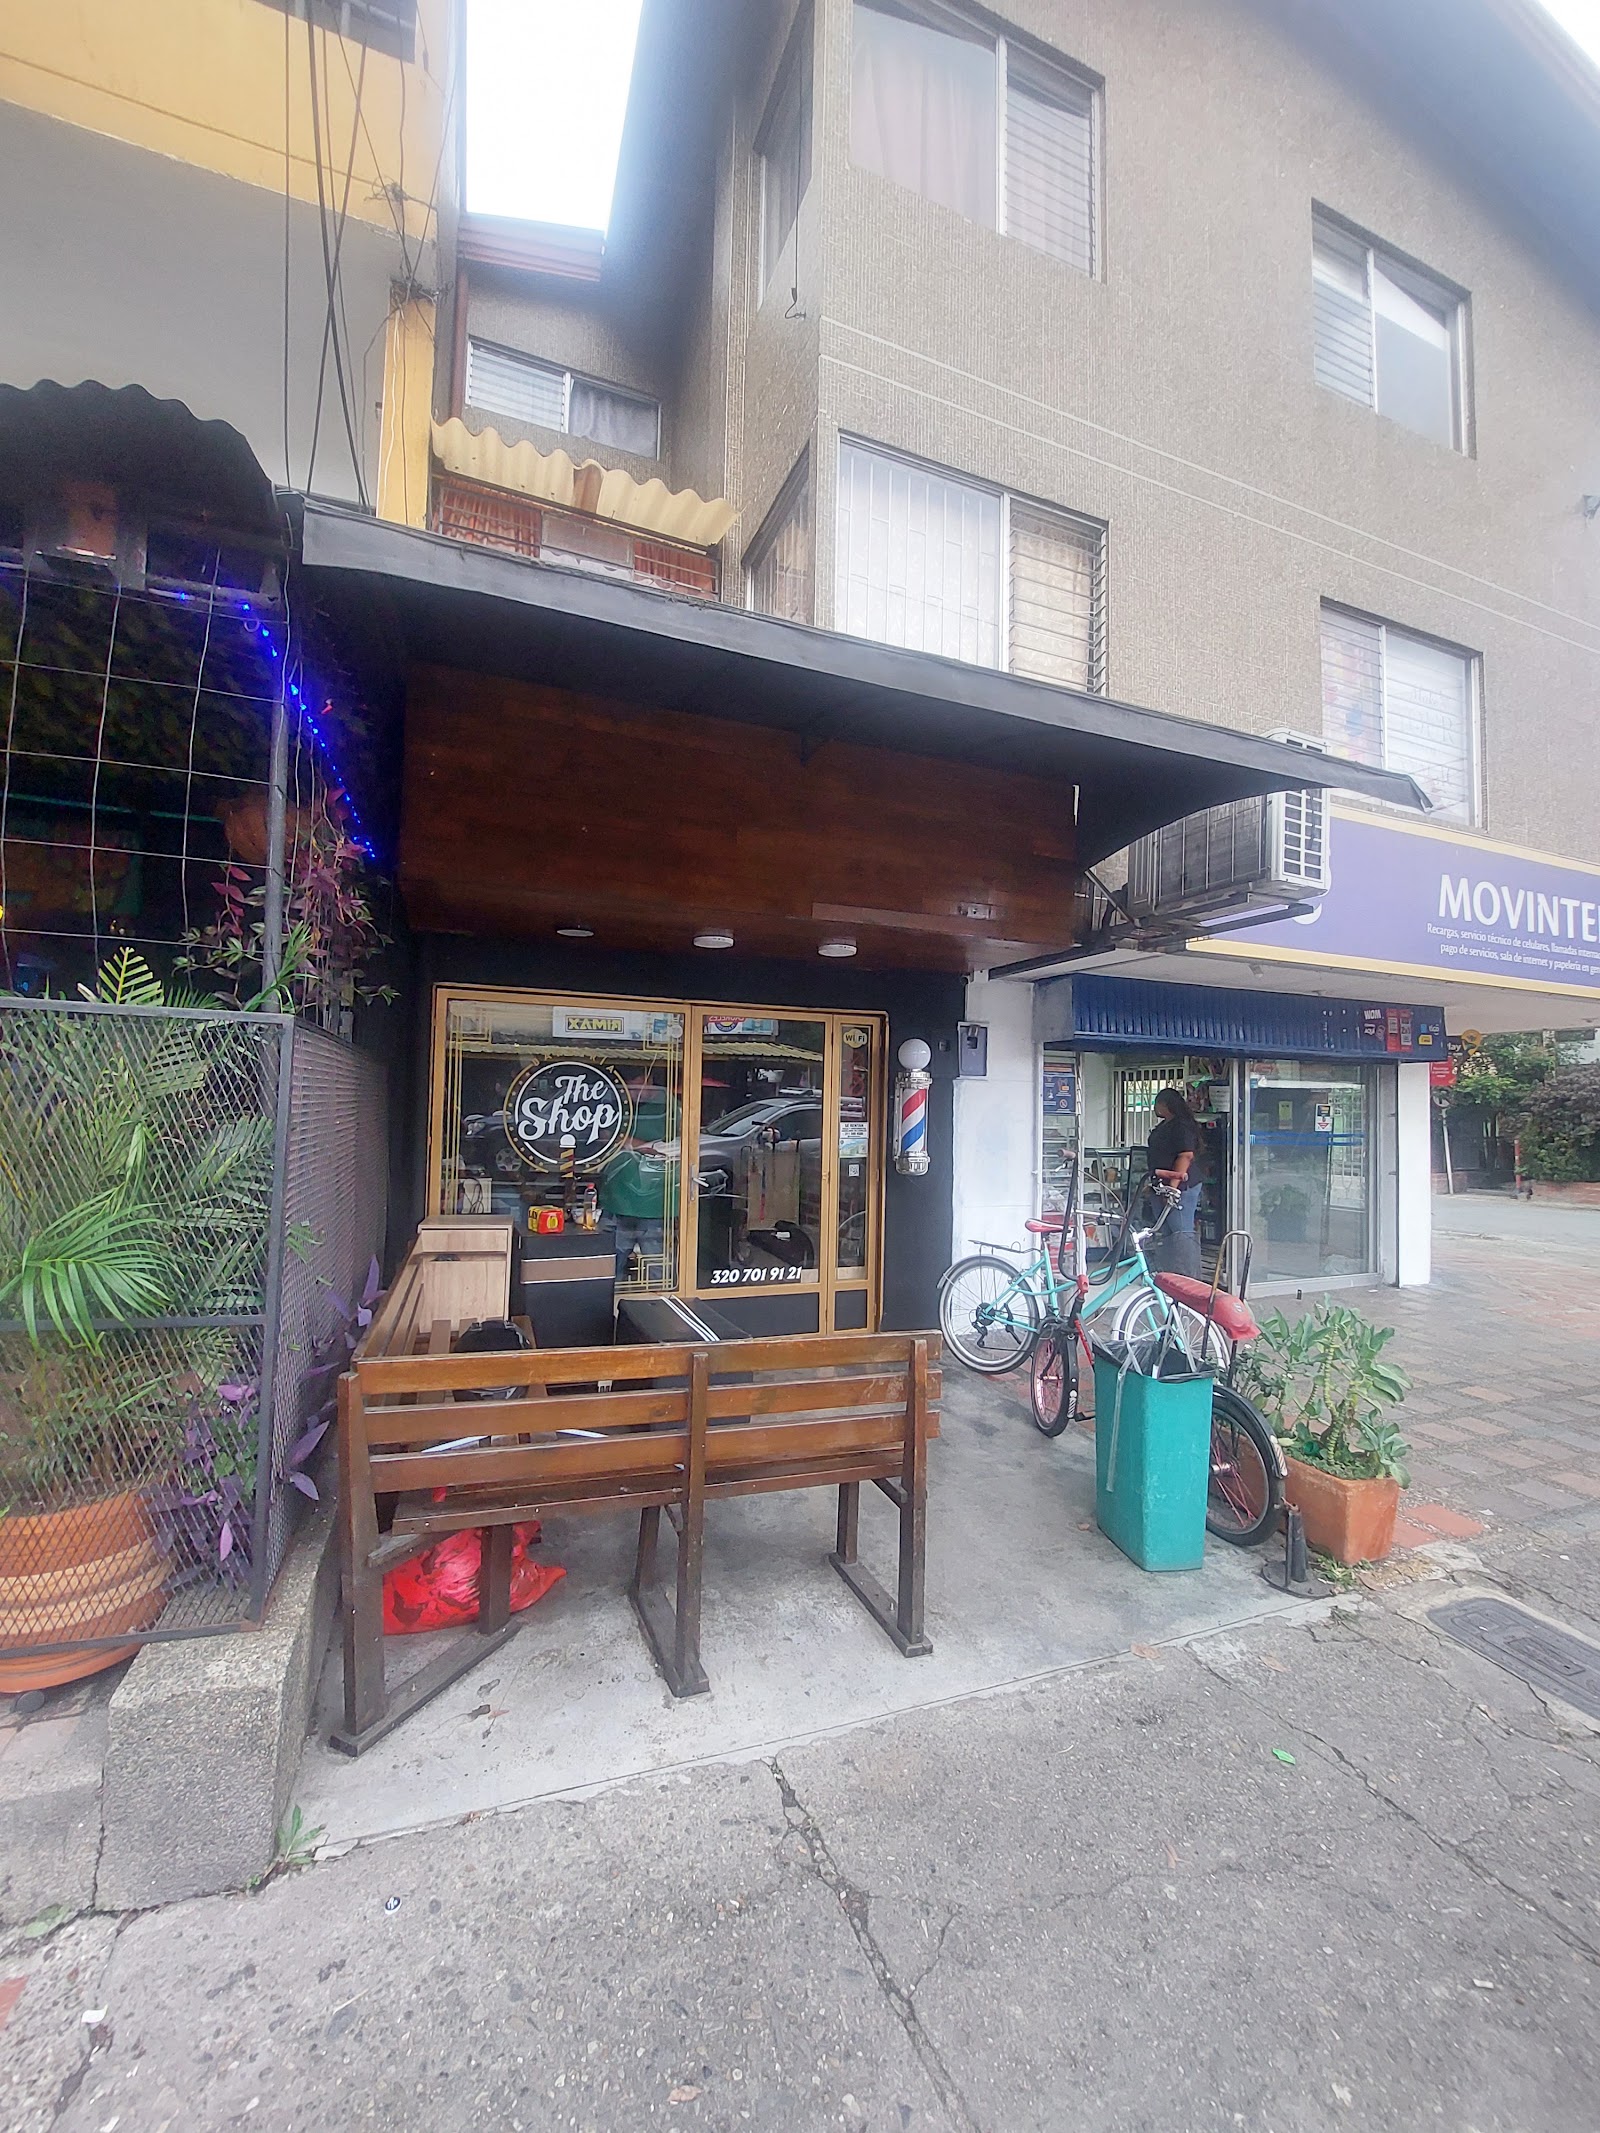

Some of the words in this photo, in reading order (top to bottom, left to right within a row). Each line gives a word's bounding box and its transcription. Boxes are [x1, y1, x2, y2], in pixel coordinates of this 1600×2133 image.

[1438, 874, 1600, 943] MOVINTE
[1426, 922, 1459, 939] Recargas,
[1460, 930, 1487, 942] servicio
[1487, 932, 1512, 946] técnico
[1512, 936, 1522, 947] de
[1521, 938, 1550, 953] celulares,
[1440, 943, 1458, 956] pago
[1458, 943, 1469, 955] de
[1469, 947, 1499, 961] servicios,
[1499, 950, 1513, 962] sala
[1513, 951, 1523, 963] de
[1548, 960, 1554, 970] y
[1581, 964, 1590, 972] en
[1364, 1009, 1381, 1020] WOM
[555, 1074, 608, 1104] The
[518, 1095, 620, 1145] Shop
[710, 1269, 740, 1284] 320
[741, 1267, 767, 1282] 701
[769, 1266, 785, 1281] 91
[786, 1265, 802, 1280] 21
